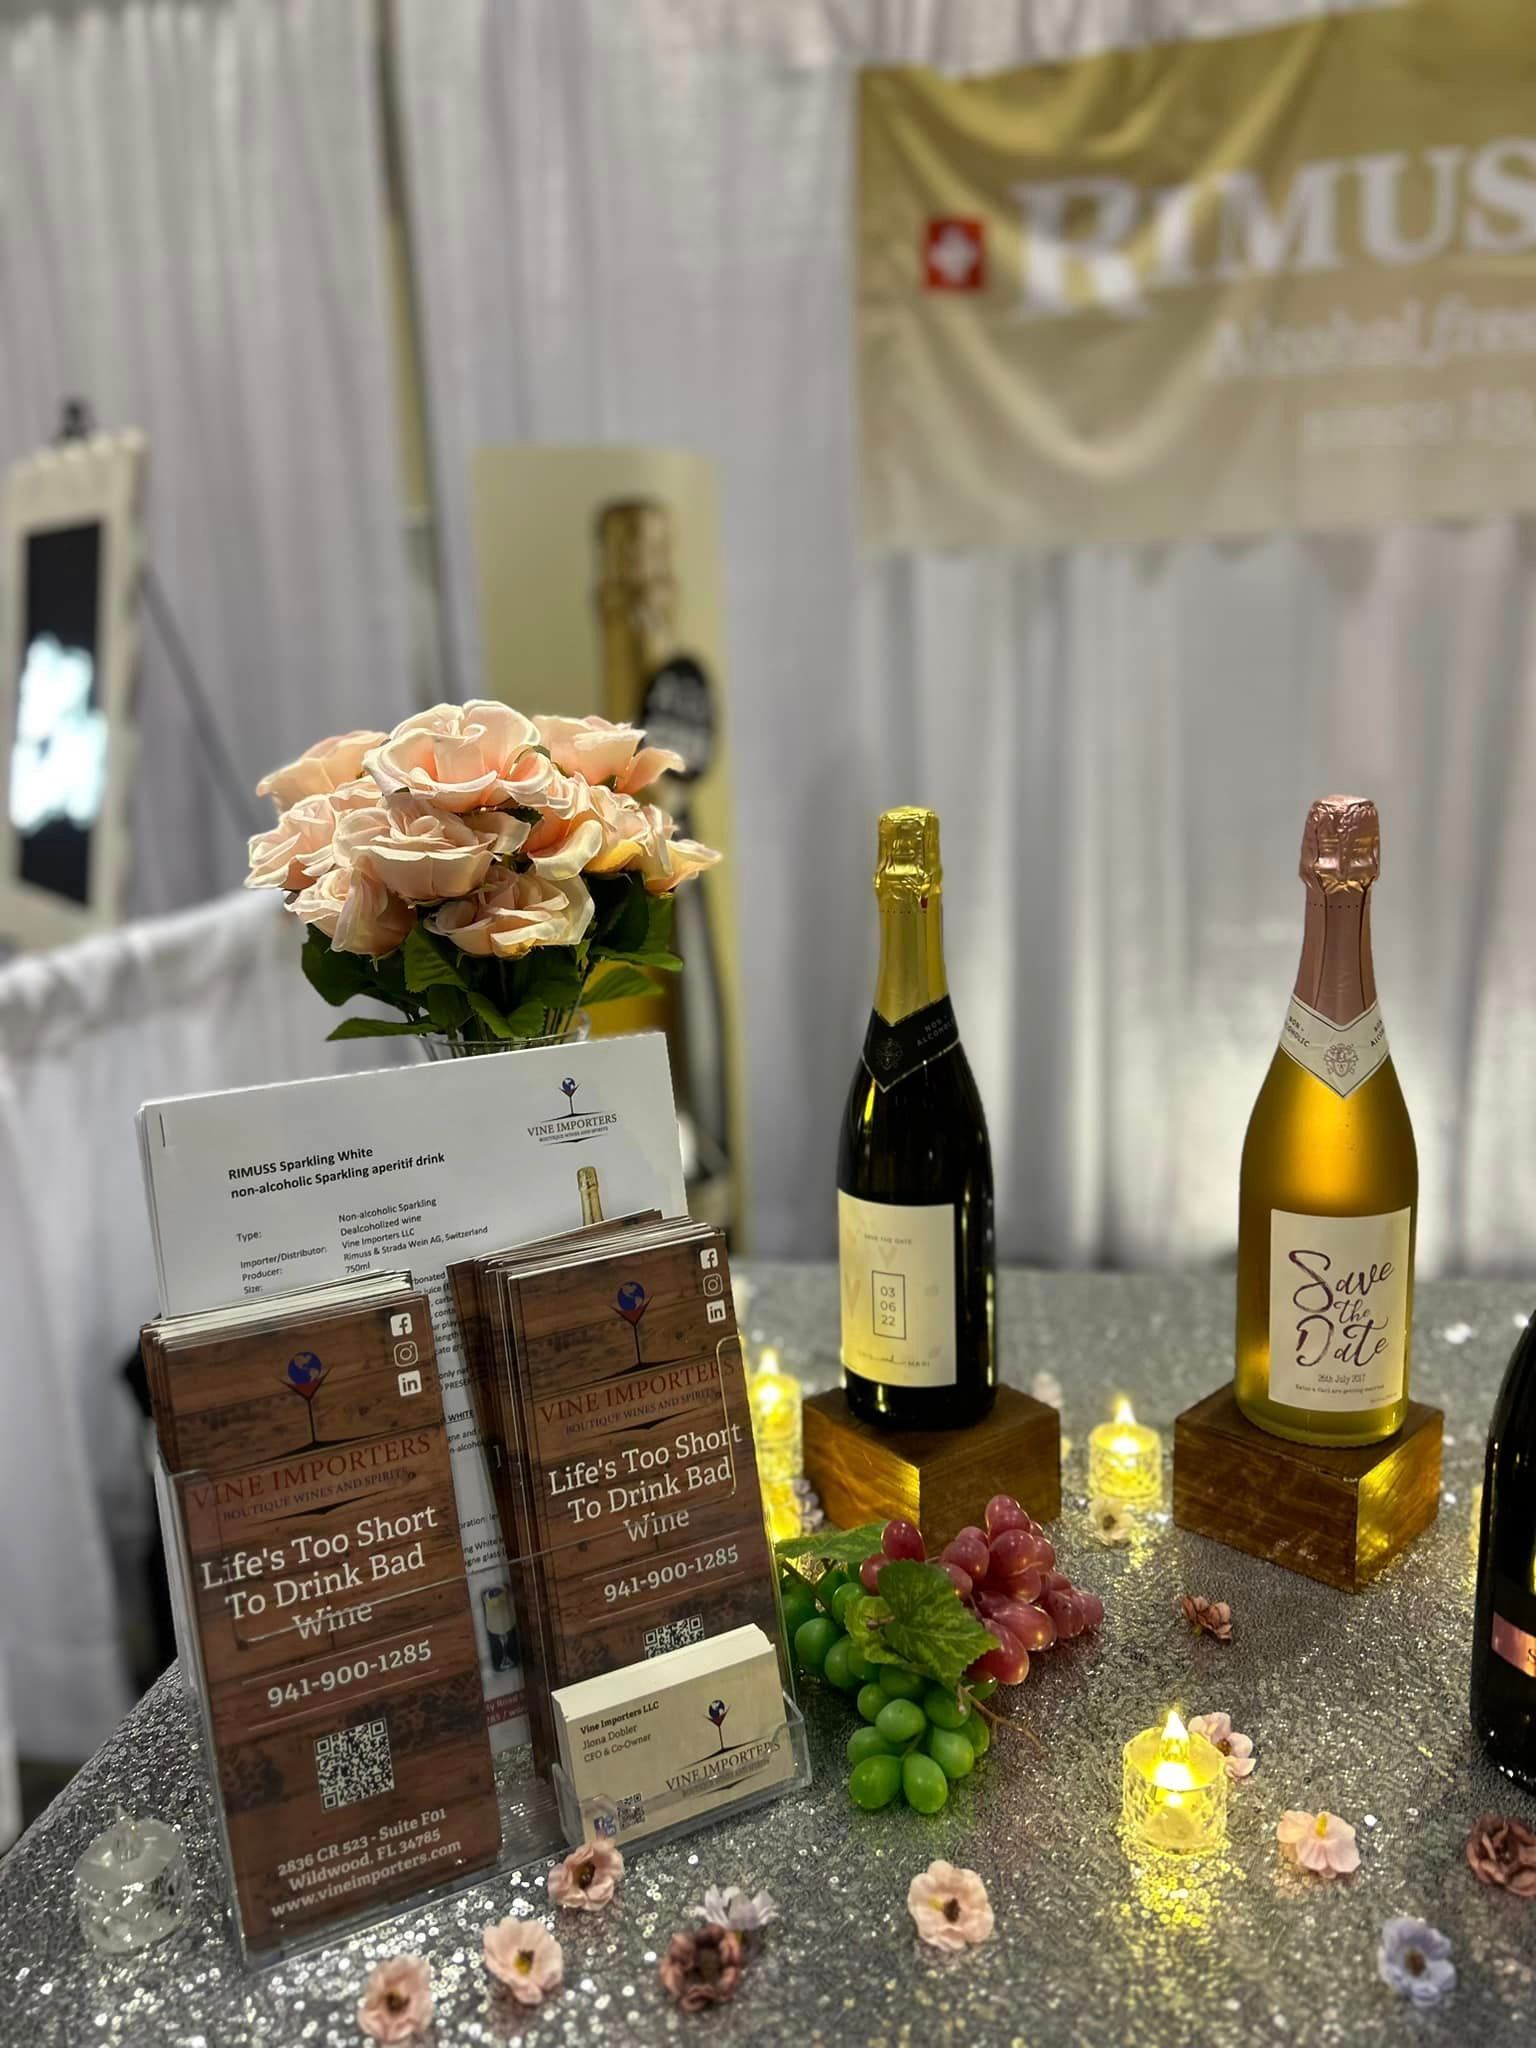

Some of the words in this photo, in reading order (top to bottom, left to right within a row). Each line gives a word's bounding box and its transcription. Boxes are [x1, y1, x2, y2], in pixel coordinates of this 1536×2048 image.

[527, 1124, 554, 1137] VINE
[556, 1113, 617, 1132] IMPORTERS
[228, 1162, 277, 1180] RIMUSS
[279, 1154, 335, 1173] Sparkling
[337, 1148, 374, 1162] White
[231, 1176, 313, 1199] non-alcoholic
[315, 1166, 370, 1185] Sparkling
[372, 1157, 413, 1175] aperitif
[416, 1152, 445, 1167] drink
[338, 1205, 398, 1223] Non-alcoholic
[399, 1197, 437, 1213] Sparkling
[340, 1219, 400, 1236] Dealcoholized
[401, 1214, 422, 1225] wine
[236, 1231, 262, 1243] Type:
[341, 1237, 360, 1249] Vine
[361, 1230, 400, 1247] Importers
[401, 1227, 415, 1238] LLC
[343, 1249, 372, 1261] Rimuss
[373, 1247, 380, 1256] &
[381, 1242, 407, 1254] Strada
[408, 1237, 429, 1248] Wein
[430, 1234, 444, 1246] AG,
[445, 1226, 488, 1242] Switzerland
[240, 1246, 328, 1269] Importer/Distributor:
[345, 1262, 371, 1274] 750ml
[242, 1268, 283, 1281] Producer:
[243, 1284, 264, 1295] Size:
[413, 1272, 446, 1284] bonated
[1288, 1248, 1396, 1314] Save
[880, 1285, 896, 1298] 03
[880, 1300, 897, 1313] 06
[881, 1314, 896, 1327] 22
[1332, 1298, 1372, 1325] the
[1294, 1312, 1391, 1368] Date
[540, 1392, 599, 1424] VINE
[602, 1359, 735, 1408] IMPORTERS
[1334, 1373, 1351, 1386] July
[448, 1408, 474, 1422] WHITE
[565, 1413, 621, 1435] BOUTIQUE
[623, 1404, 657, 1420] WINES
[658, 1398, 680, 1412] AND
[681, 1388, 717, 1404] SPIRITS
[462, 1428, 477, 1439] and
[192, 1475, 265, 1508] VINE
[273, 1433, 431, 1490] IMPORTERS
[547, 1458, 617, 1496] Life's
[622, 1445, 669, 1477] Too
[675, 1423, 743, 1459] Short
[223, 1495, 291, 1522] BOUTIQUE
[293, 1486, 333, 1504] WINES
[335, 1478, 362, 1494] AND
[364, 1468, 411, 1487] SPIRITS
[567, 1497, 601, 1524] To
[608, 1473, 681, 1514] Drink
[686, 1456, 733, 1490] Bad
[623, 1510, 690, 1543] Wine
[201, 1546, 286, 1590] Life's
[291, 1532, 349, 1565] Too
[355, 1505, 438, 1549] Short
[474, 1539, 499, 1552] White
[482, 1551, 501, 1564] glass
[224, 1590, 266, 1621] To
[273, 1561, 364, 1608] Drink
[369, 1542, 426, 1580] Bad
[604, 1543, 739, 1603] 941-900-1285
[292, 1601, 374, 1640] Wine
[267, 1640, 432, 1709] 941-900-1285
[580, 1722, 600, 1736] Vine
[600, 1709, 642, 1732] Importers
[643, 1700, 660, 1714] LLC
[608, 1725, 638, 1742] Dobler
[584, 1750, 603, 1764] CEO
[603, 1747, 610, 1757] &
[611, 1734, 652, 1755] Co-Owner
[665, 1768, 700, 1791] VINE
[703, 1740, 780, 1777] IMPORTERS
[277, 1854, 315, 1877] 2836
[316, 1844, 341, 1861] CR
[342, 1836, 368, 1855] 523
[379, 1818, 419, 1841] Suite
[376, 1844, 398, 1861] FL
[399, 1828, 441, 1854] 34785
[271, 1841, 462, 1918] www.vineimporters.com
